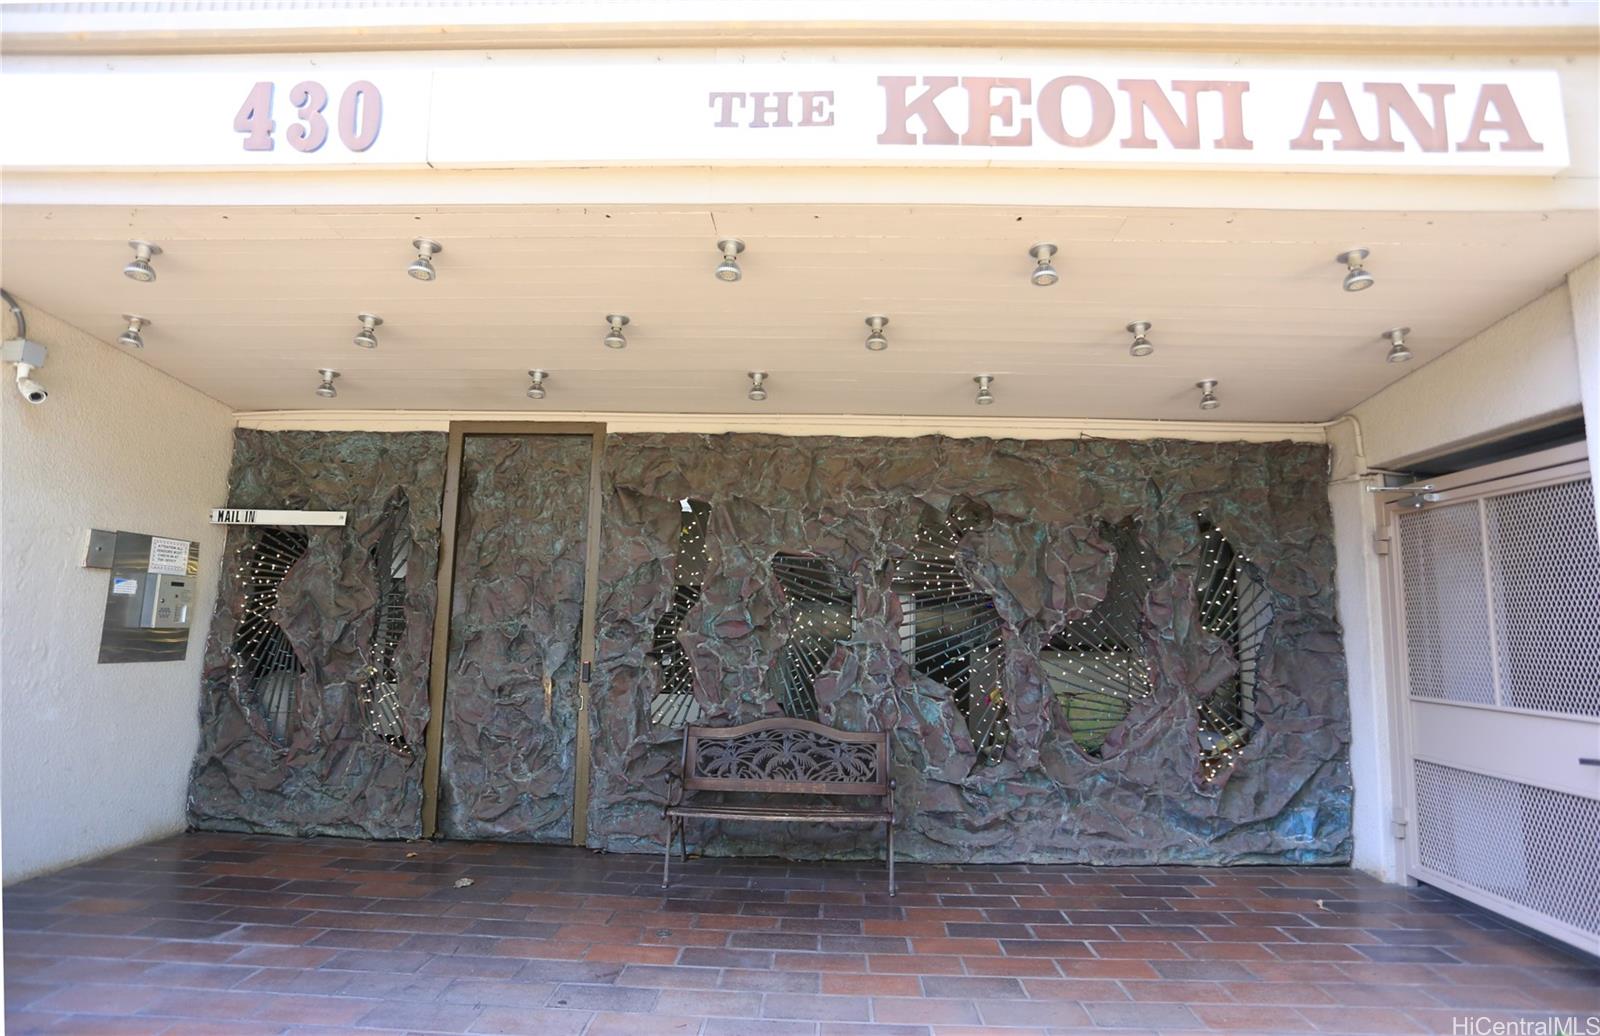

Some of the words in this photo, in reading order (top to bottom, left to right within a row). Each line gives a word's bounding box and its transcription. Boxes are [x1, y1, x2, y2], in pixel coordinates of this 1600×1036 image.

[233, 80, 383, 153] 430
[709, 90, 835, 128] THE
[876, 75, 1254, 150] KEONI
[1289, 81, 1545, 152] ANA
[217, 510, 240, 523] MAIL
[244, 510, 256, 523] IN
